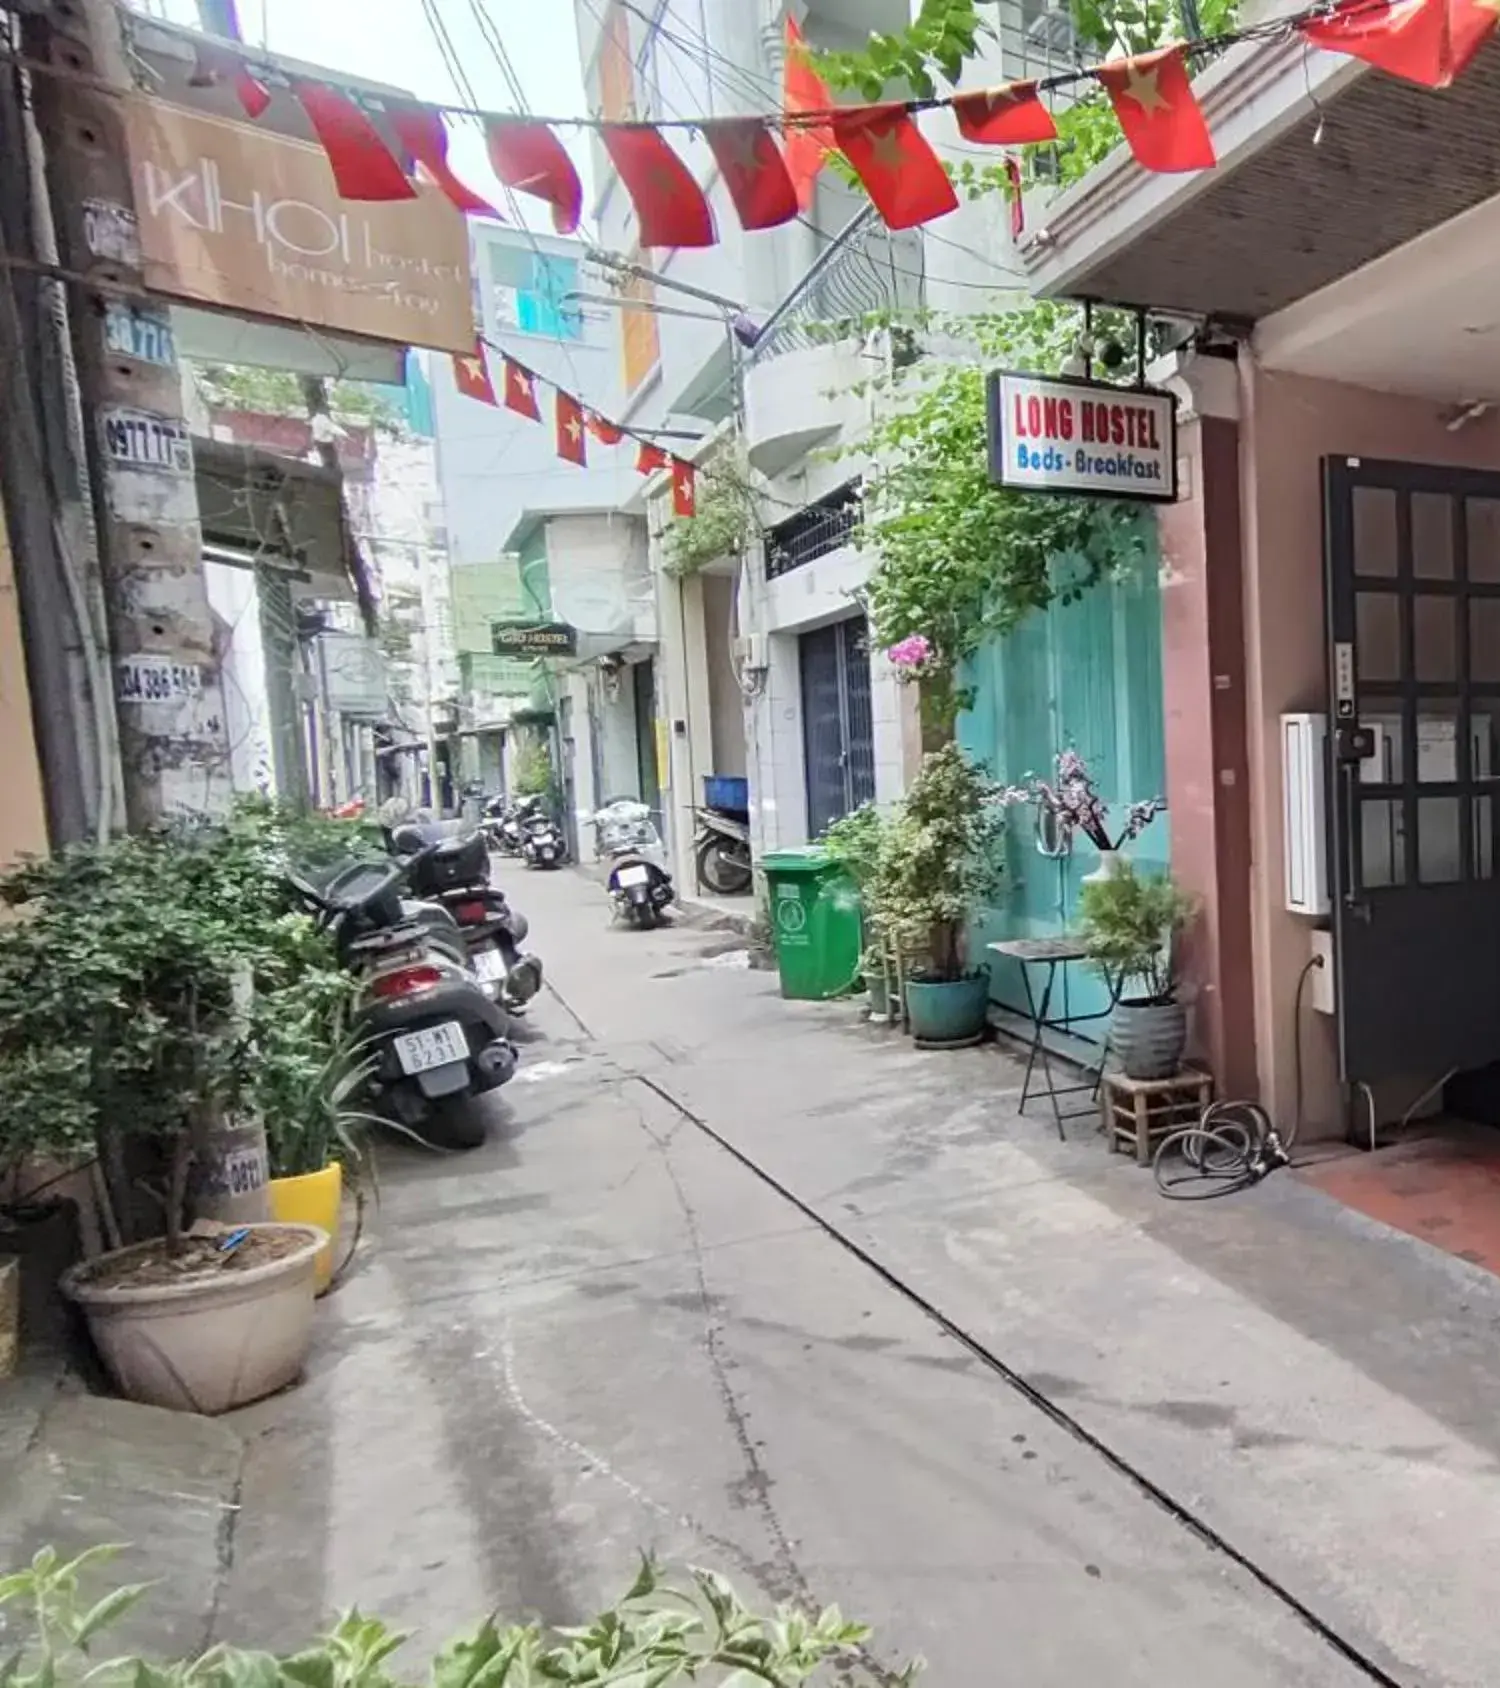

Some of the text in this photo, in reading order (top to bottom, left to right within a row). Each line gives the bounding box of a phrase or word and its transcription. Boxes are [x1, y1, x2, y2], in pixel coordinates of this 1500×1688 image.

[1014, 393, 1159, 450] LONG HOSTEL
[1075, 449, 1161, 480] Breakfast
